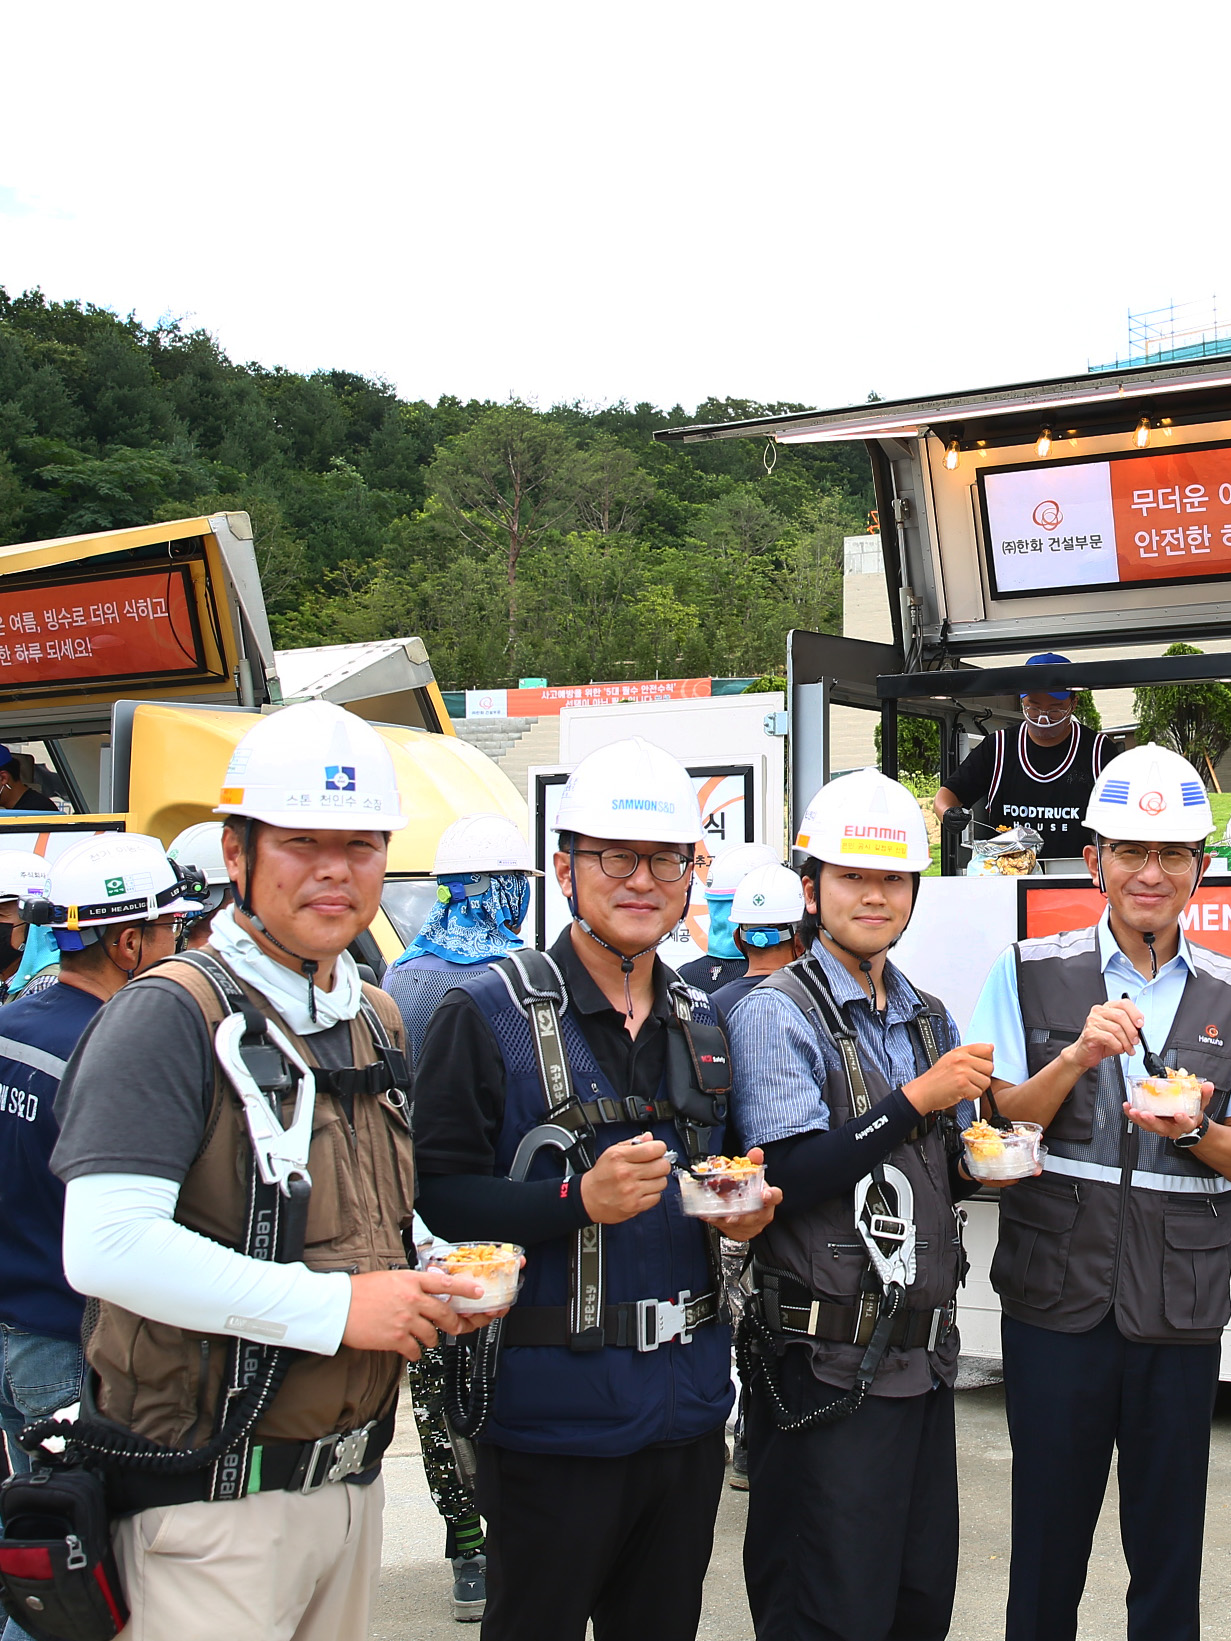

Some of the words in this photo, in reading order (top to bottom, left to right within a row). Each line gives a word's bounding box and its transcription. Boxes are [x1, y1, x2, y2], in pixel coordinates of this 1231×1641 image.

[1131, 482, 1210, 516] 무더운
[1047, 534, 1103, 552] 건설부문
[1133, 524, 1212, 558] 안전한
[9, 611, 41, 634] 여름,
[43, 607, 87, 631] 빙수로
[89, 601, 121, 625] 더위
[123, 597, 169, 622] 식히고
[14, 642, 43, 664] 하루
[46, 636, 93, 661] 되세요!
[541, 688, 582, 700] 사고예방을
[584, 690, 601, 698] 위한
[1003, 804, 1080, 820] FOODTRUCK
